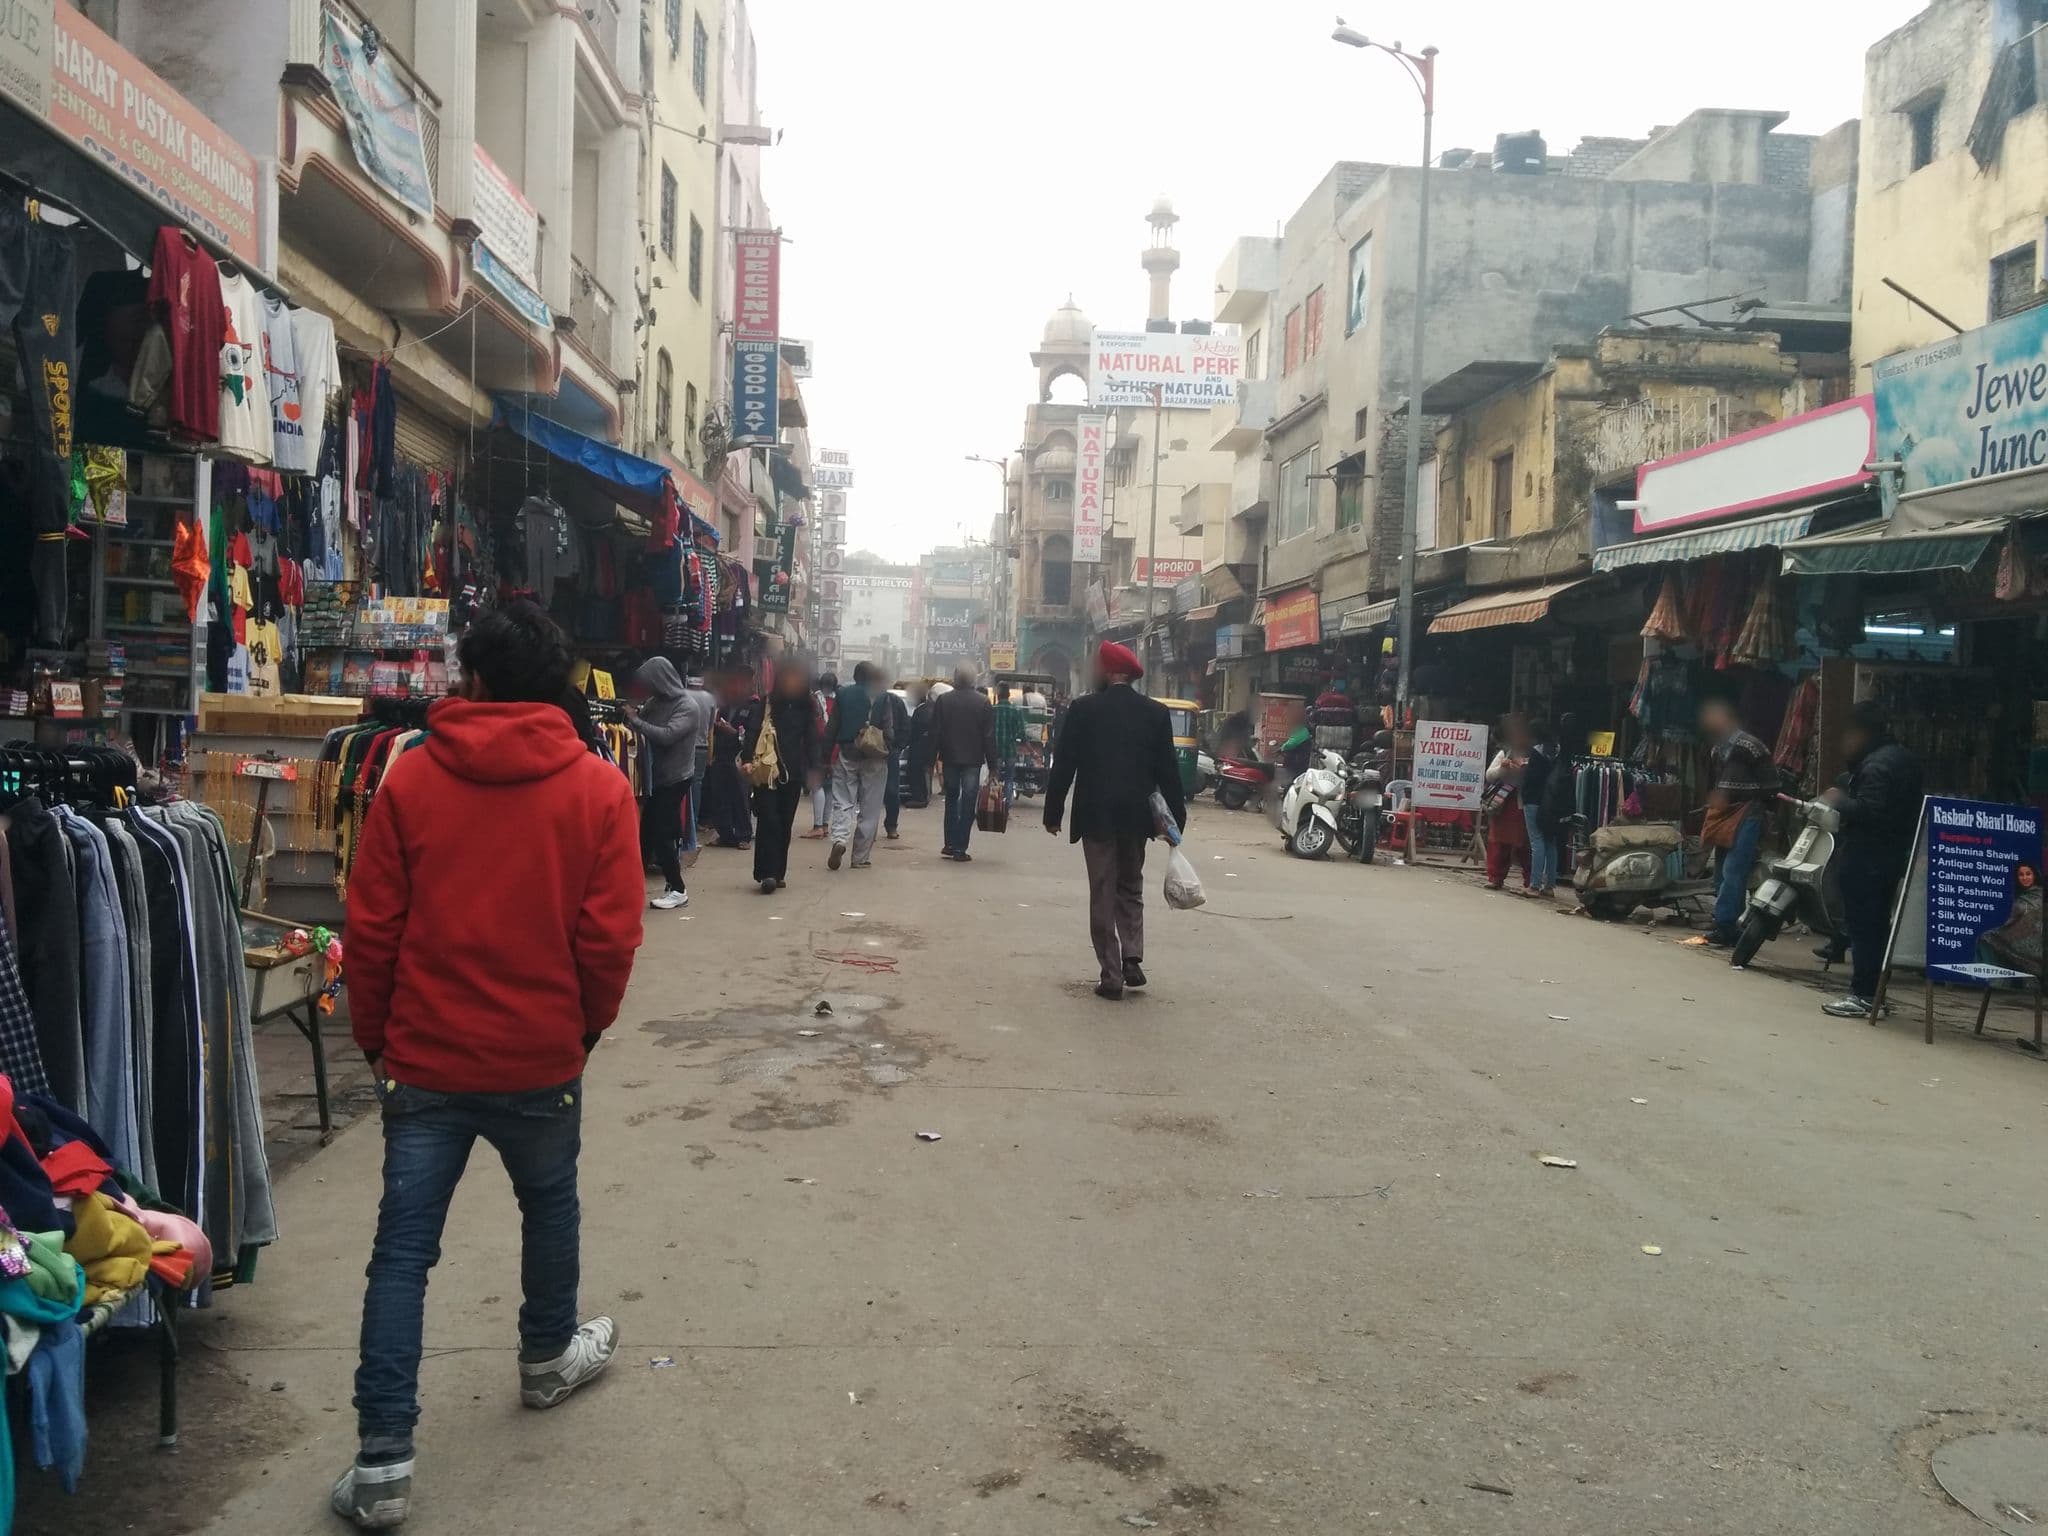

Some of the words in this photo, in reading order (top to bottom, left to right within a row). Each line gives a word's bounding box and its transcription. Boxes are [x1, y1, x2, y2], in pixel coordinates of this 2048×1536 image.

[123, 79, 187, 163] PUSTAK
[191, 133, 255, 214] BHANDAR
[743, 247, 769, 324] DECENT
[737, 342, 775, 353] COTTAGE
[1099, 353, 1185, 374] NATURAL
[1193, 357, 1240, 374] PERF
[744, 353, 768, 395] GOOD
[1165, 383, 1233, 397] NATURAL
[1967, 363, 2048, 419] Jewe
[744, 400, 767, 431] DAY
[273, 421, 304, 437] INDIA
[821, 451, 848, 464] HOTEL
[817, 470, 853, 485] HARI
[1080, 426, 1100, 522] NATURAL
[763, 594, 786, 604] CAFE
[928, 641, 966, 649] SATYAM
[1431, 727, 1472, 741] HOTEL
[1420, 741, 1455, 756] YATRI
[1454, 760, 1465, 768] OF
[1933, 806, 1974, 827] Kashmir
[1976, 810, 2004, 831] Shawl
[2006, 814, 2036, 835] House
[1938, 844, 1984, 857] Pashmina
[1986, 849, 2019, 861] Shawls
[1938, 857, 1974, 870] Antique
[1976, 862, 2009, 873] Shawls
[1938, 870, 1979, 883] Cahmere
[1982, 875, 2006, 886] Wool
[1938, 883, 1955, 894] Silk
[1958, 886, 2003, 899] Pashmina
[1938, 897, 1955, 907] Silk
[1957, 899, 1995, 911] Scarves
[1938, 910, 1955, 920] Silk
[1957, 912, 1981, 923] Wool
[1938, 924, 1974, 935] Carpets
[1938, 937, 1962, 949] Rugs
